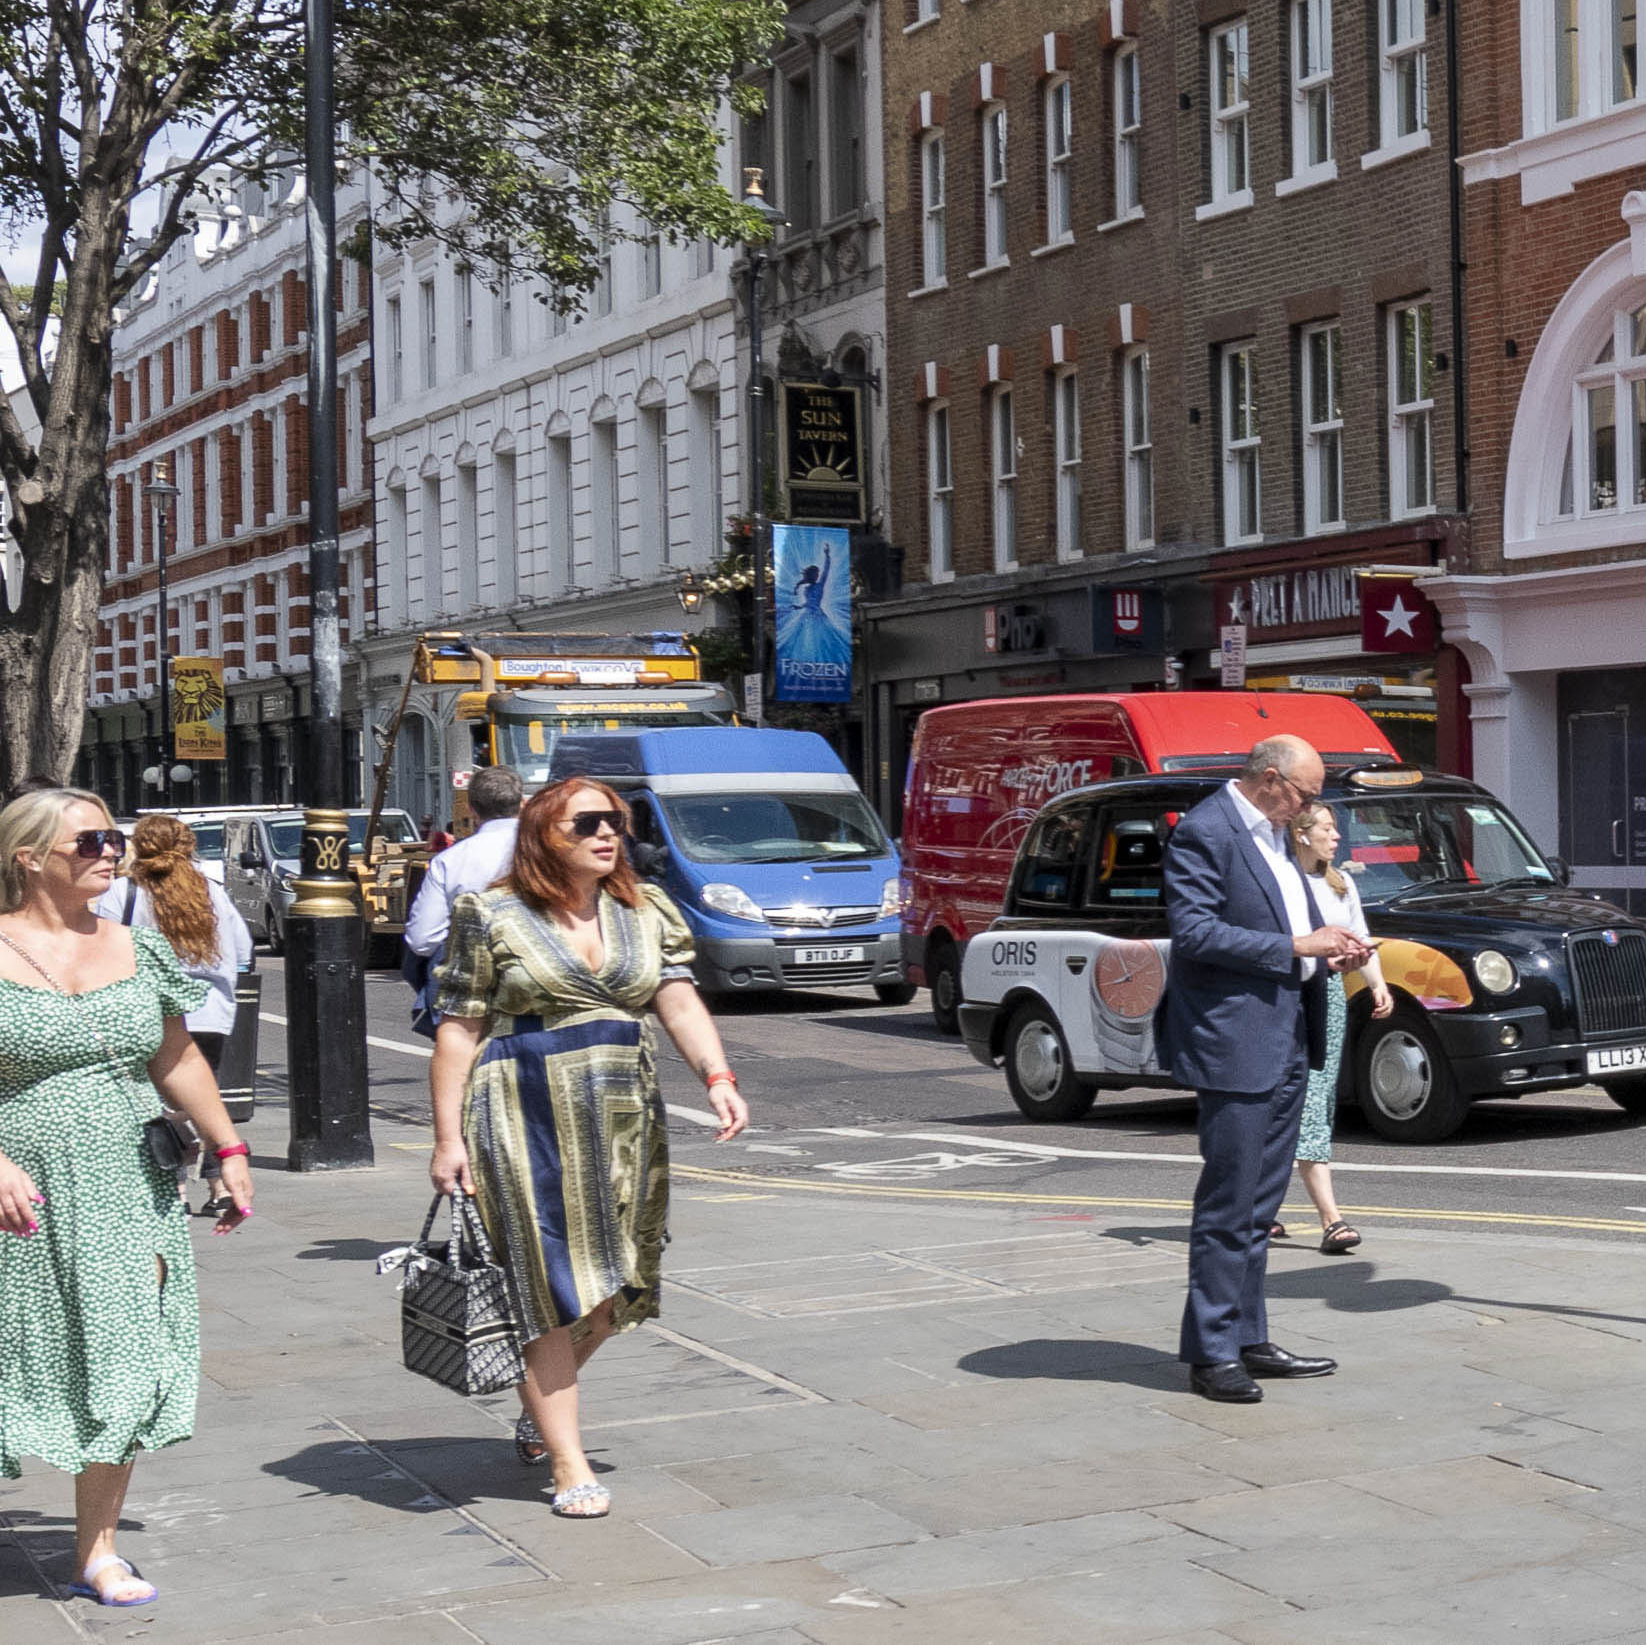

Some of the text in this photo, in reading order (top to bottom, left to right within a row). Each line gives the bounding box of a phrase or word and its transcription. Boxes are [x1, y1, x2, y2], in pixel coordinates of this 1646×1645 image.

[808, 395, 833, 406] THE
[801, 410, 842, 426] SUN
[797, 429, 849, 442] TAVERN
[1251, 566, 1361, 627] PRET A MANGE
[781, 658, 847, 680] FROZEN
[992, 940, 1037, 966] ORIS
[1599, 1047, 1634, 1068] LL13
